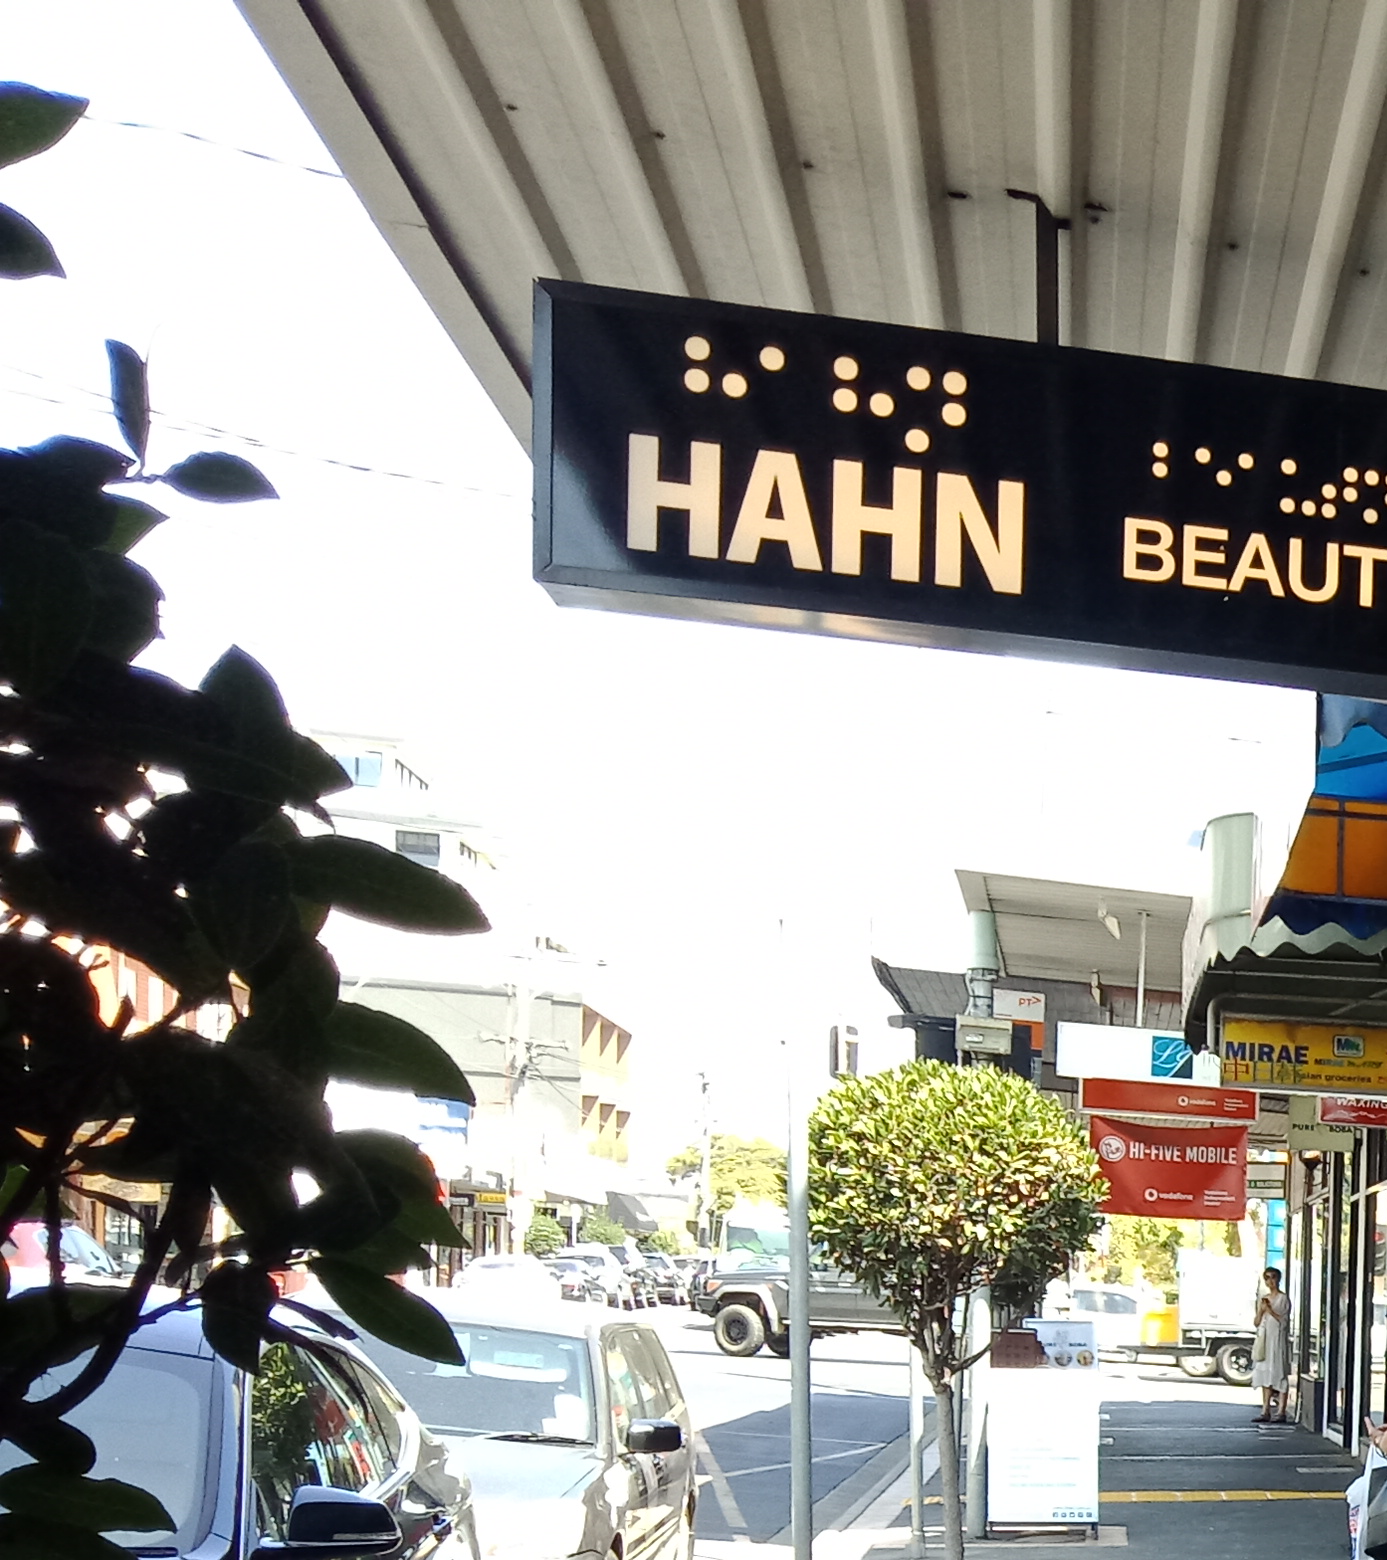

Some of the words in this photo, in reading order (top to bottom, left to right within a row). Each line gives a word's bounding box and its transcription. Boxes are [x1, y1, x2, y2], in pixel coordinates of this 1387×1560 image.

[626, 433, 1025, 595] HAHN
[1225, 1041, 1309, 1064] MIRAE
[1324, 1072, 1373, 1083] groceries
[1292, 1123, 1315, 1131] PURE
[1128, 1141, 1182, 1163] HI-FIVE
[1185, 1146, 1238, 1165] MOBILE
